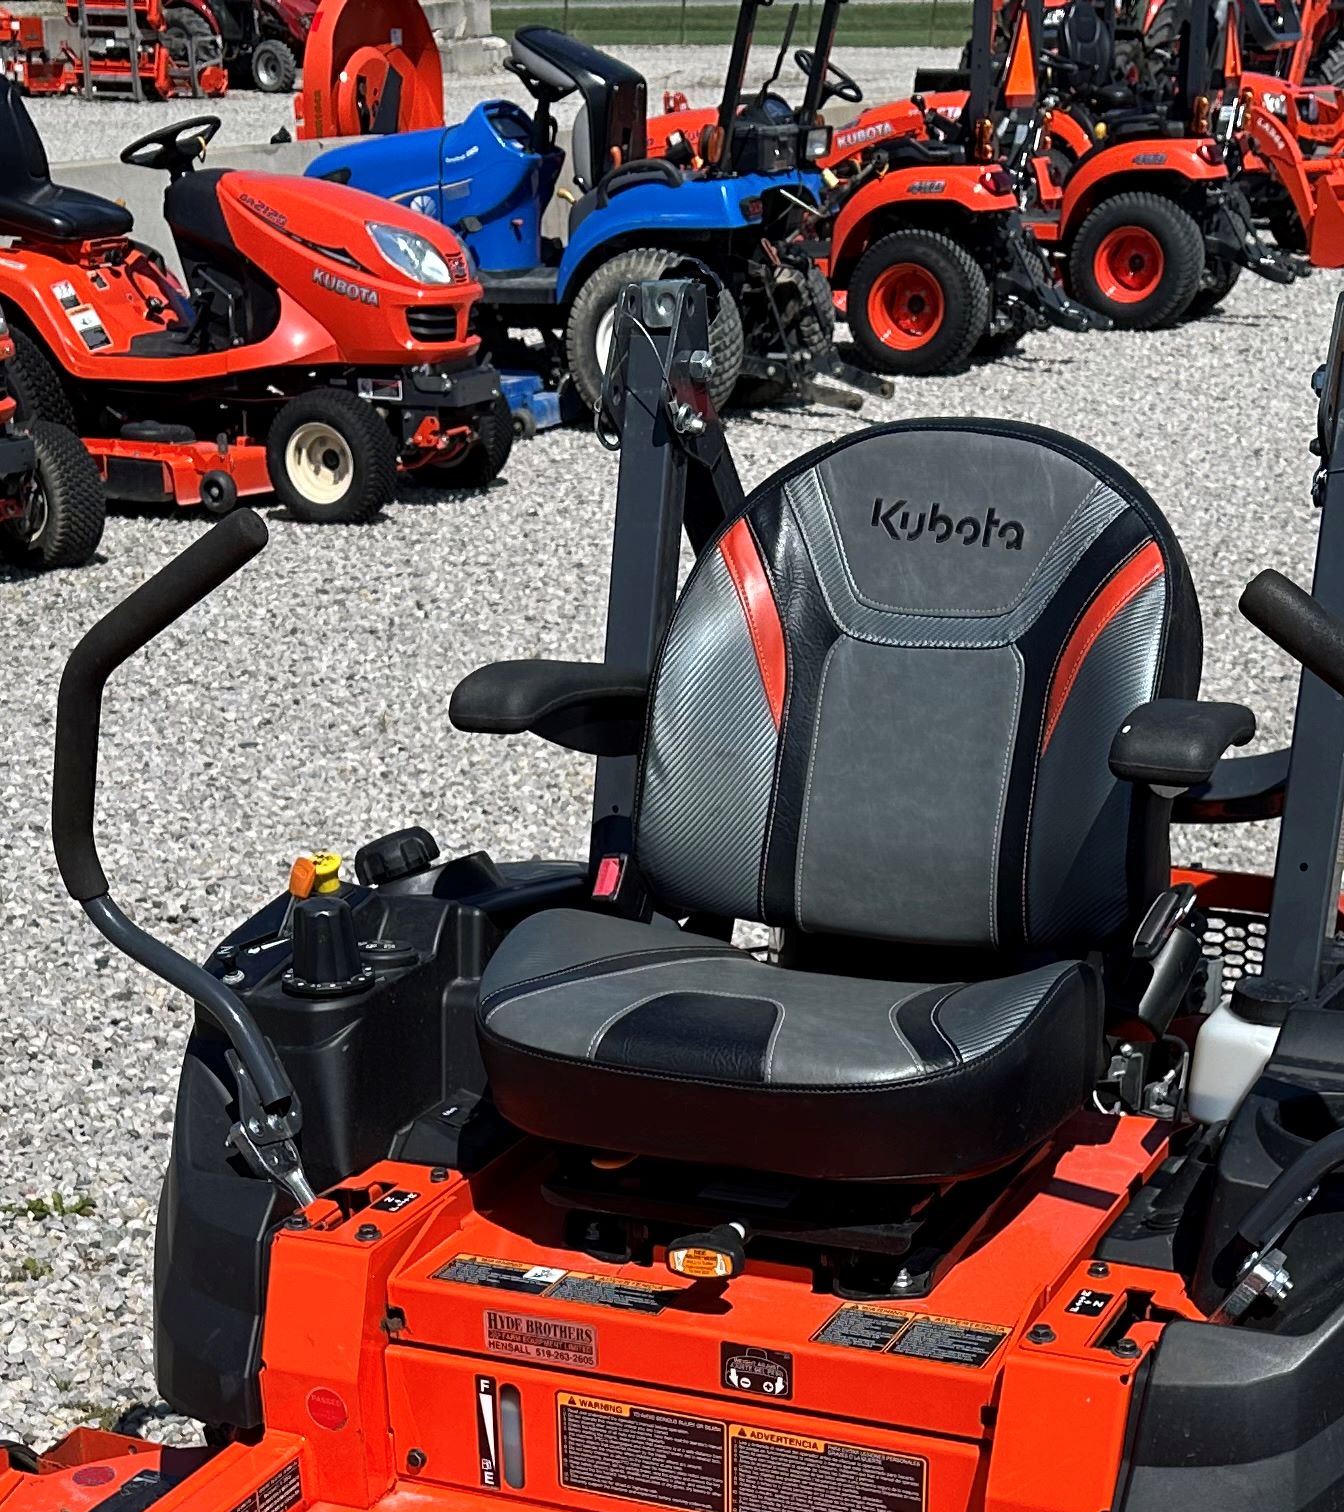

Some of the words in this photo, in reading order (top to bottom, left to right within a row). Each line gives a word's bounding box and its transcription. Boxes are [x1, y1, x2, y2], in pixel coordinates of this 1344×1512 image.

[836, 121, 893, 149] KUBOTA
[311, 267, 381, 309] KUBOTA
[870, 497, 1025, 550] Kubota
[486, 1311, 522, 1333] HYDE
[525, 1317, 593, 1343] BROTHERS
[488, 1339, 531, 1355] HENSALL
[479, 1378, 490, 1393] F
[578, 1397, 623, 1414] WARNING
[749, 1429, 819, 1451] ADVERTENCIA
[483, 1470, 495, 1486] E
